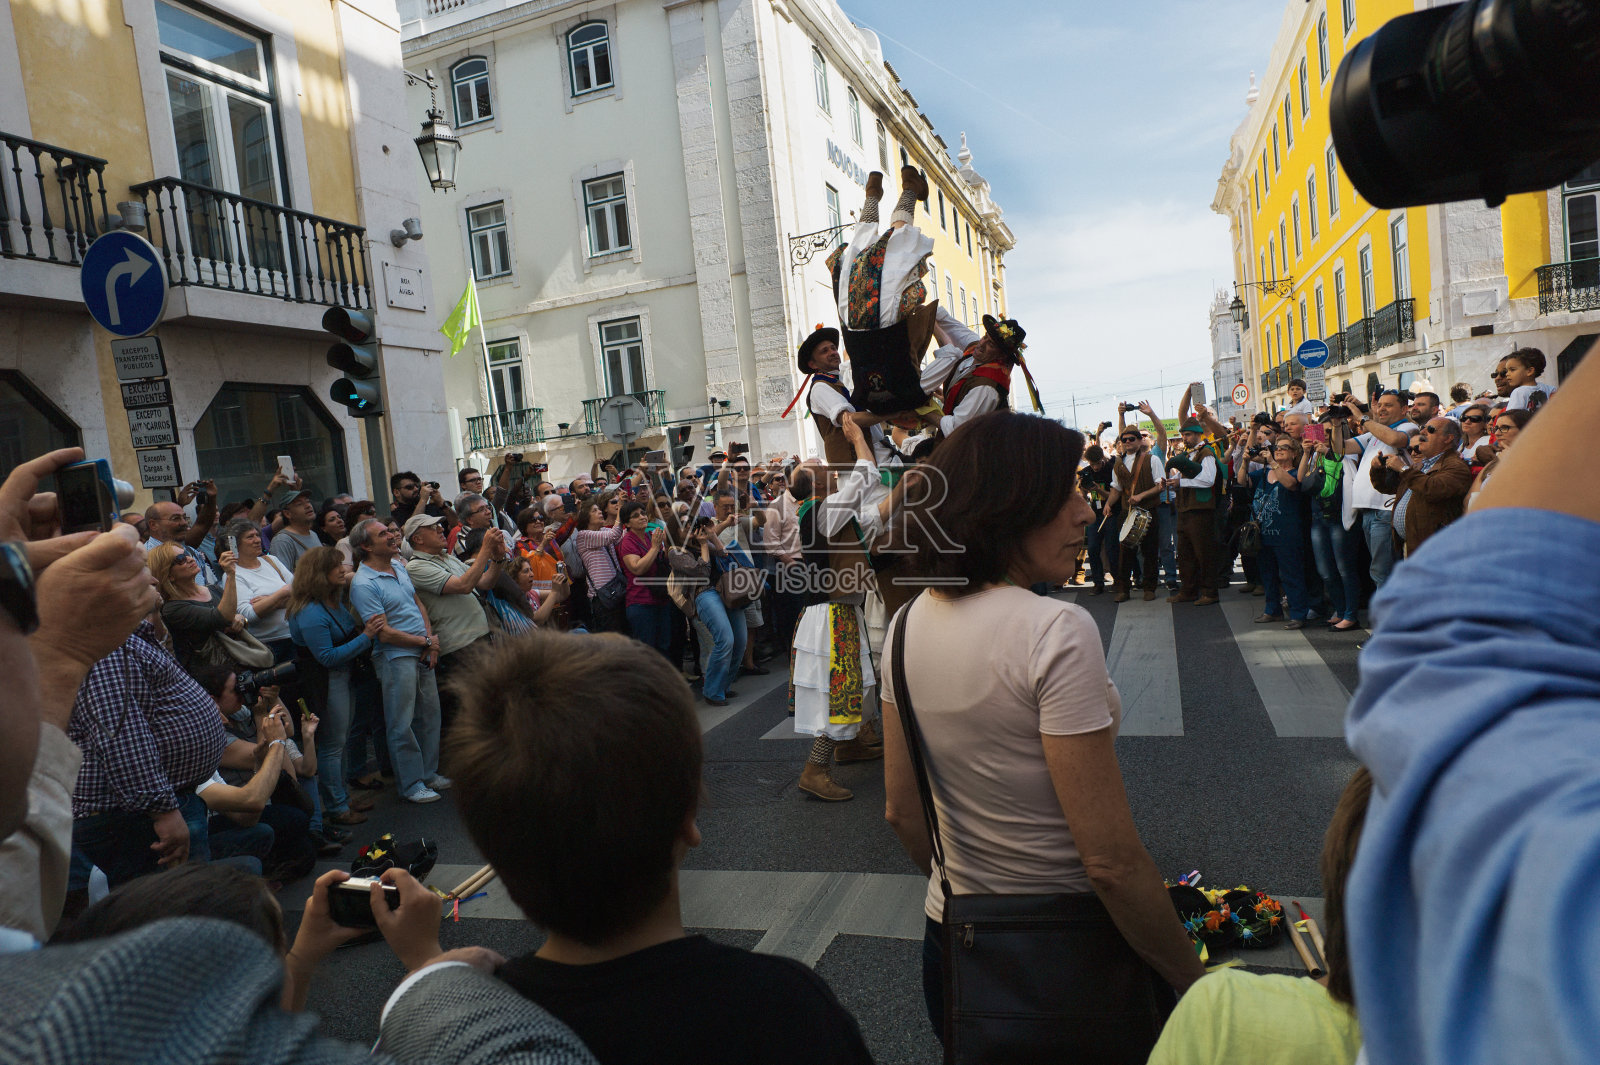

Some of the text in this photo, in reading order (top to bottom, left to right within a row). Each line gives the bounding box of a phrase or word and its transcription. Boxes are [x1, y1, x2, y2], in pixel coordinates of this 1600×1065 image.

[826, 137, 853, 178] NOVO
[122, 347, 149, 355] EXCEPTO
[116, 353, 159, 363] TRANSPORTES
[129, 383, 159, 394] EXCEPTO
[124, 392, 168, 405] RESIDENTES
[1235, 390, 1246, 399] 30
[136, 410, 161, 419] EXCEPTO
[135, 434, 171, 445] DE TURISMO
[144, 454, 166, 463] Excepto
[144, 465, 163, 473] Cargas
